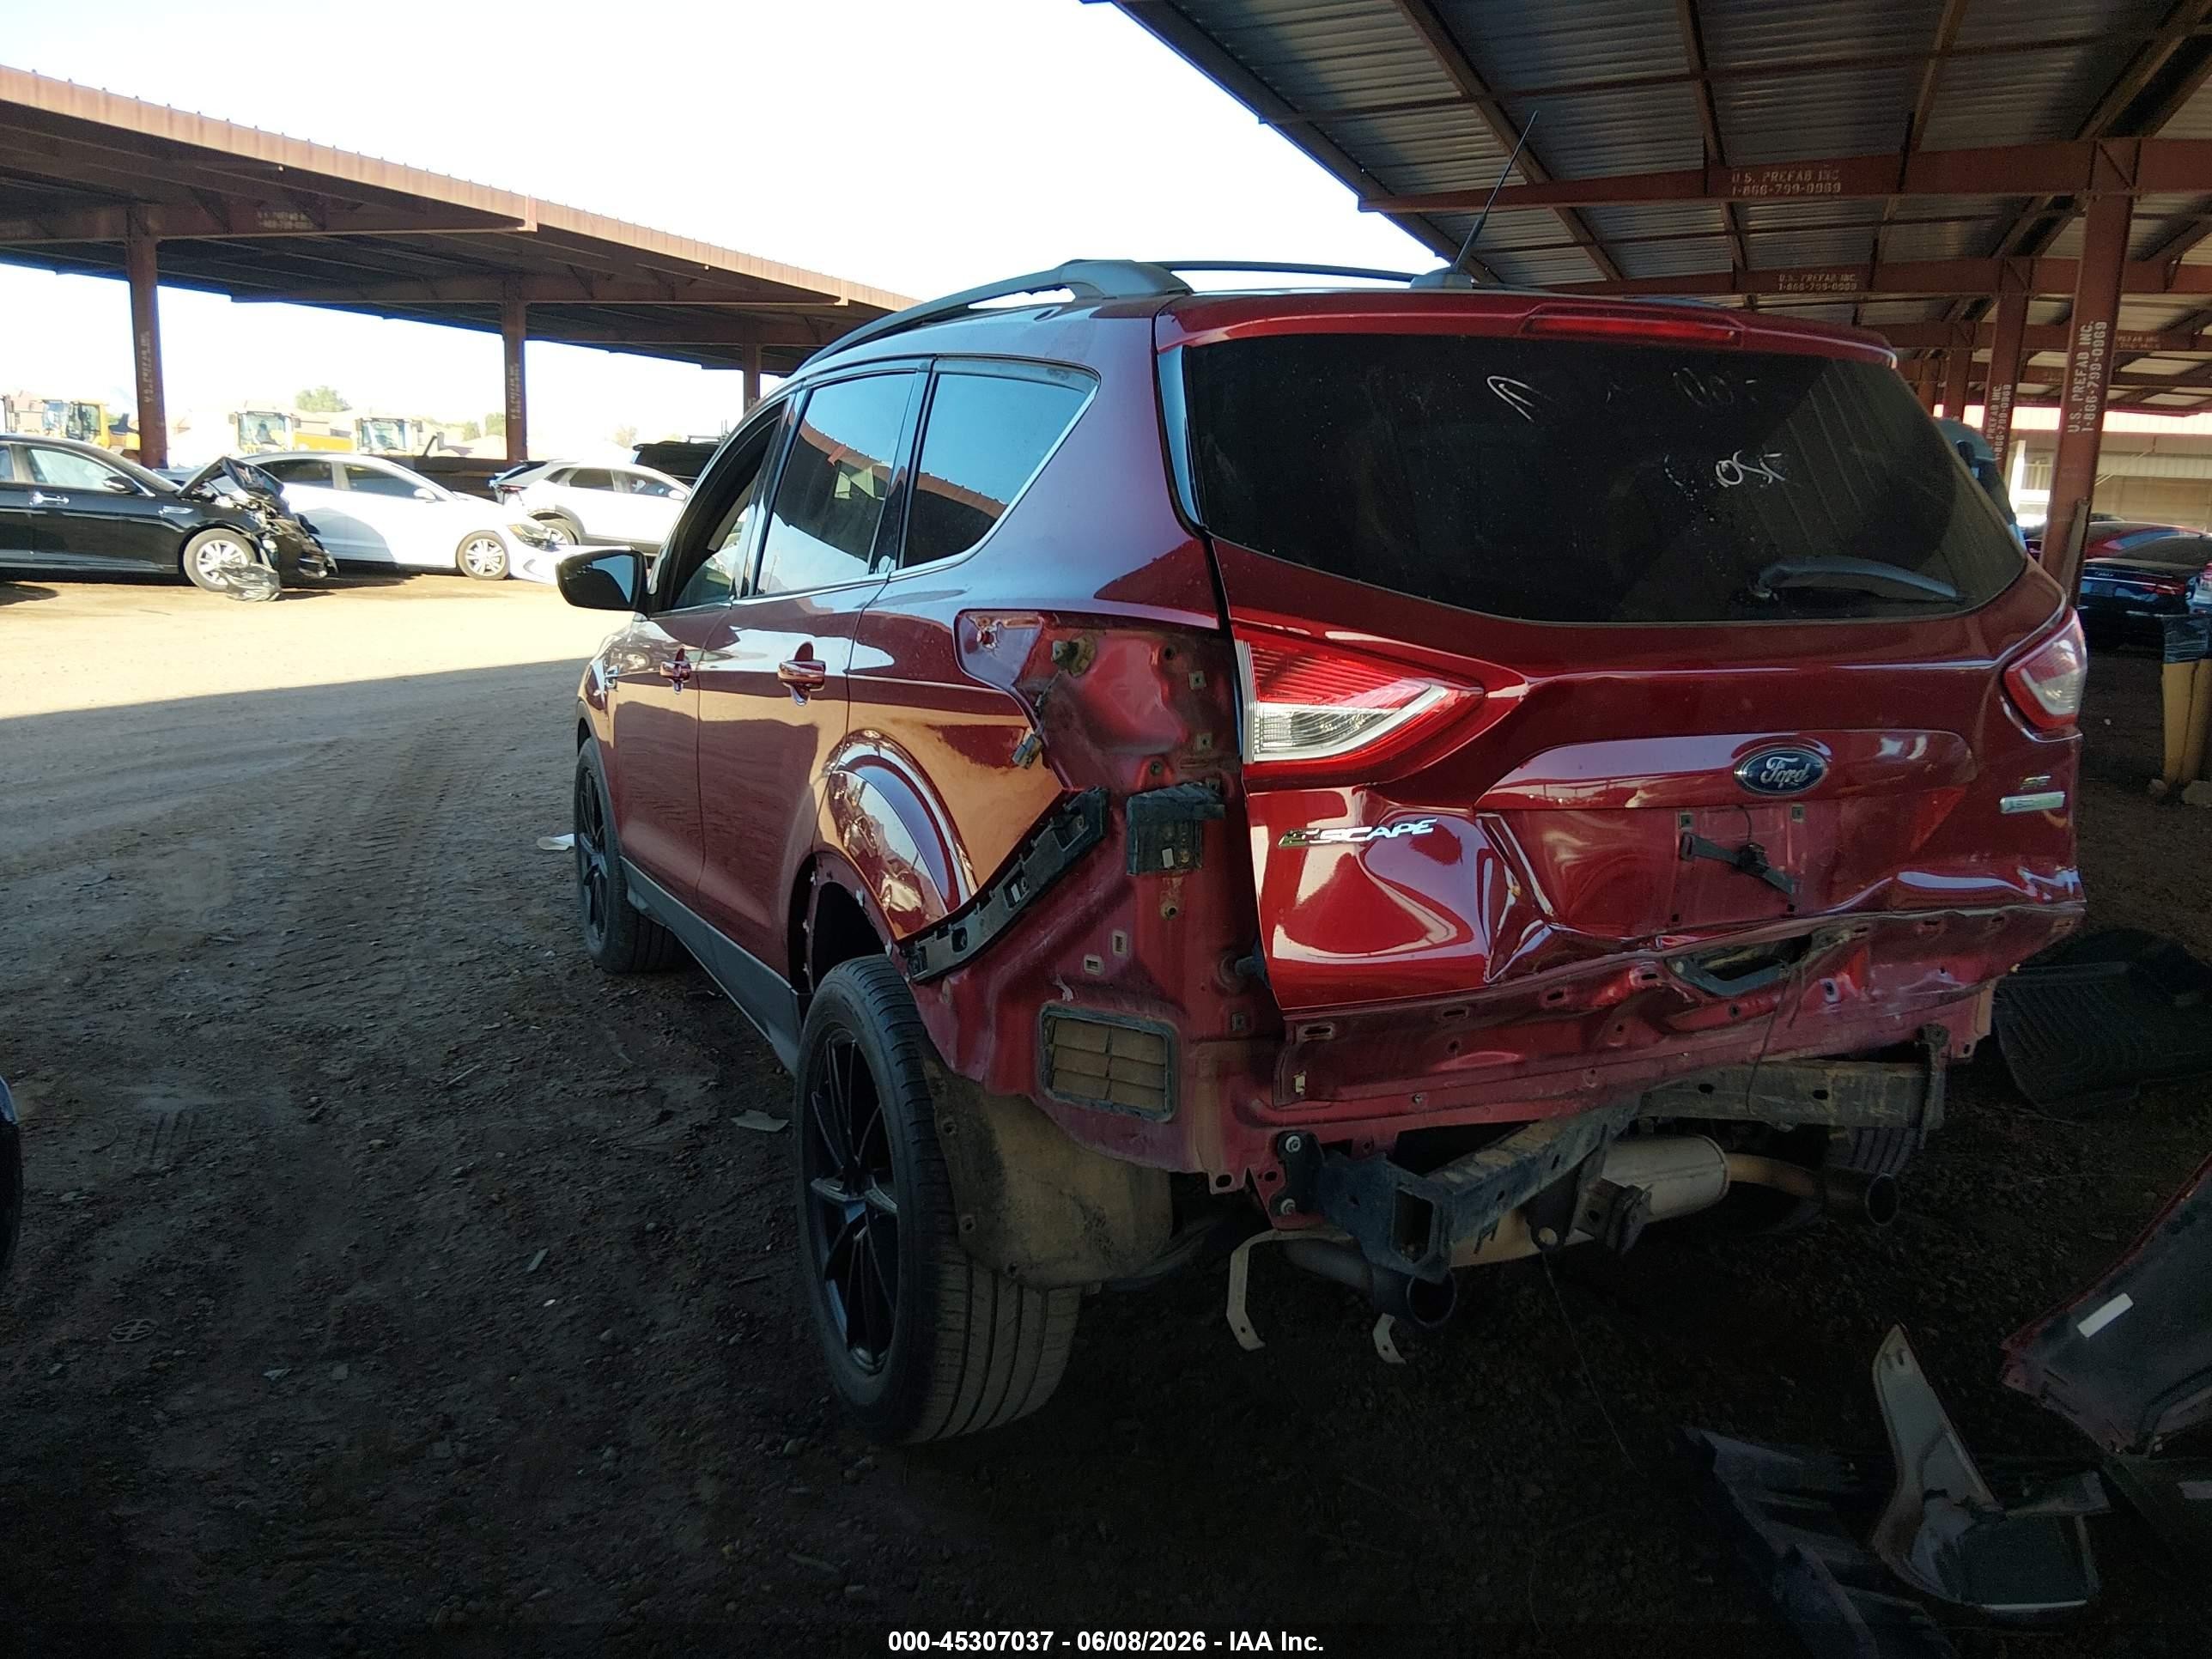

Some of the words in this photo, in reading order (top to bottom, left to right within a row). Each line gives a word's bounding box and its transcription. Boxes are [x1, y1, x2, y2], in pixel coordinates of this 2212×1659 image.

[1762, 170, 1812, 182] PREFAB
[2078, 321, 2094, 345] INC.
[2071, 351, 2089, 402] PREFAB
[2081, 321, 2107, 432] 1-866-799-0969
[2067, 408, 2082, 433] U.S.
[1760, 757, 1811, 789] Ford
[1279, 817, 1438, 848] ESCAPE
